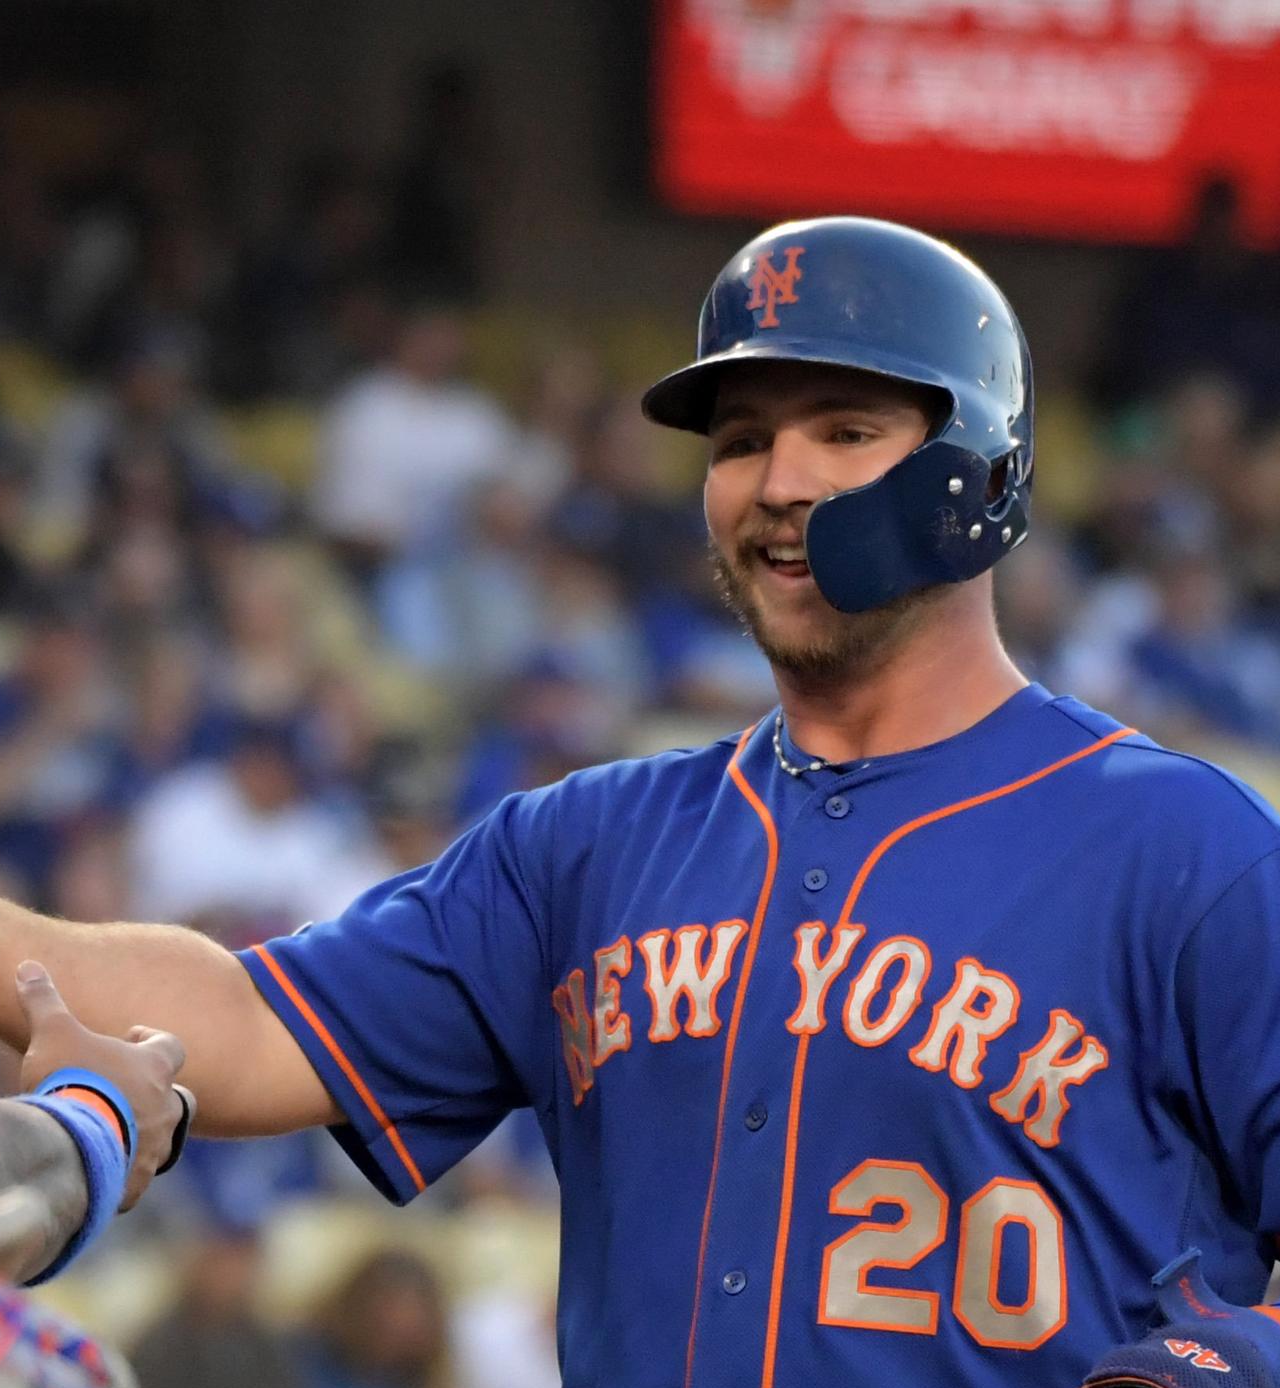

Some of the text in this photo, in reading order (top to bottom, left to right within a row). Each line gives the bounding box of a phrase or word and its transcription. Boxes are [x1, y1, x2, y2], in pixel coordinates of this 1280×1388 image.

[552, 918, 1110, 1149] NEW YORK
[816, 1157, 1069, 1351] 20
